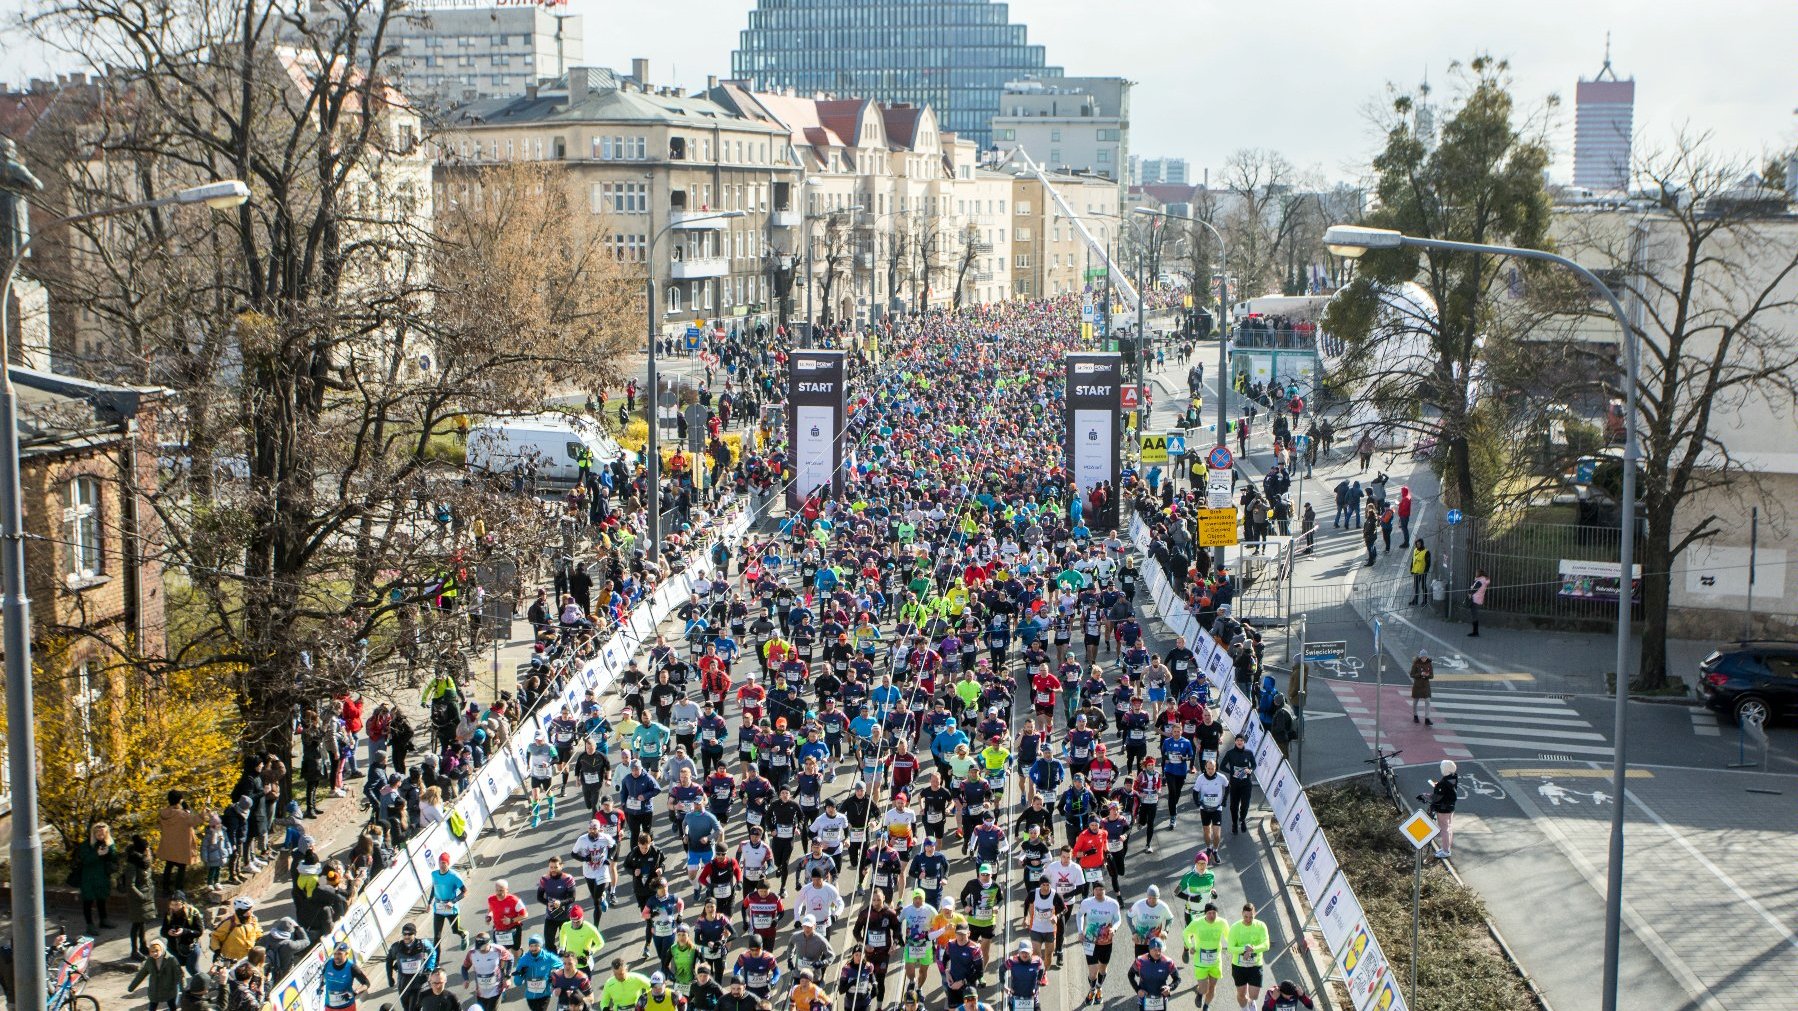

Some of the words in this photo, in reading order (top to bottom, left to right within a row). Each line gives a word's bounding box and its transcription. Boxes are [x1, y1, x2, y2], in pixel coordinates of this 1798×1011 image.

[798, 382, 833, 392] START
[1075, 385, 1111, 395] START
[1125, 389, 1137, 400] A
[1143, 438, 1167, 449] AA
